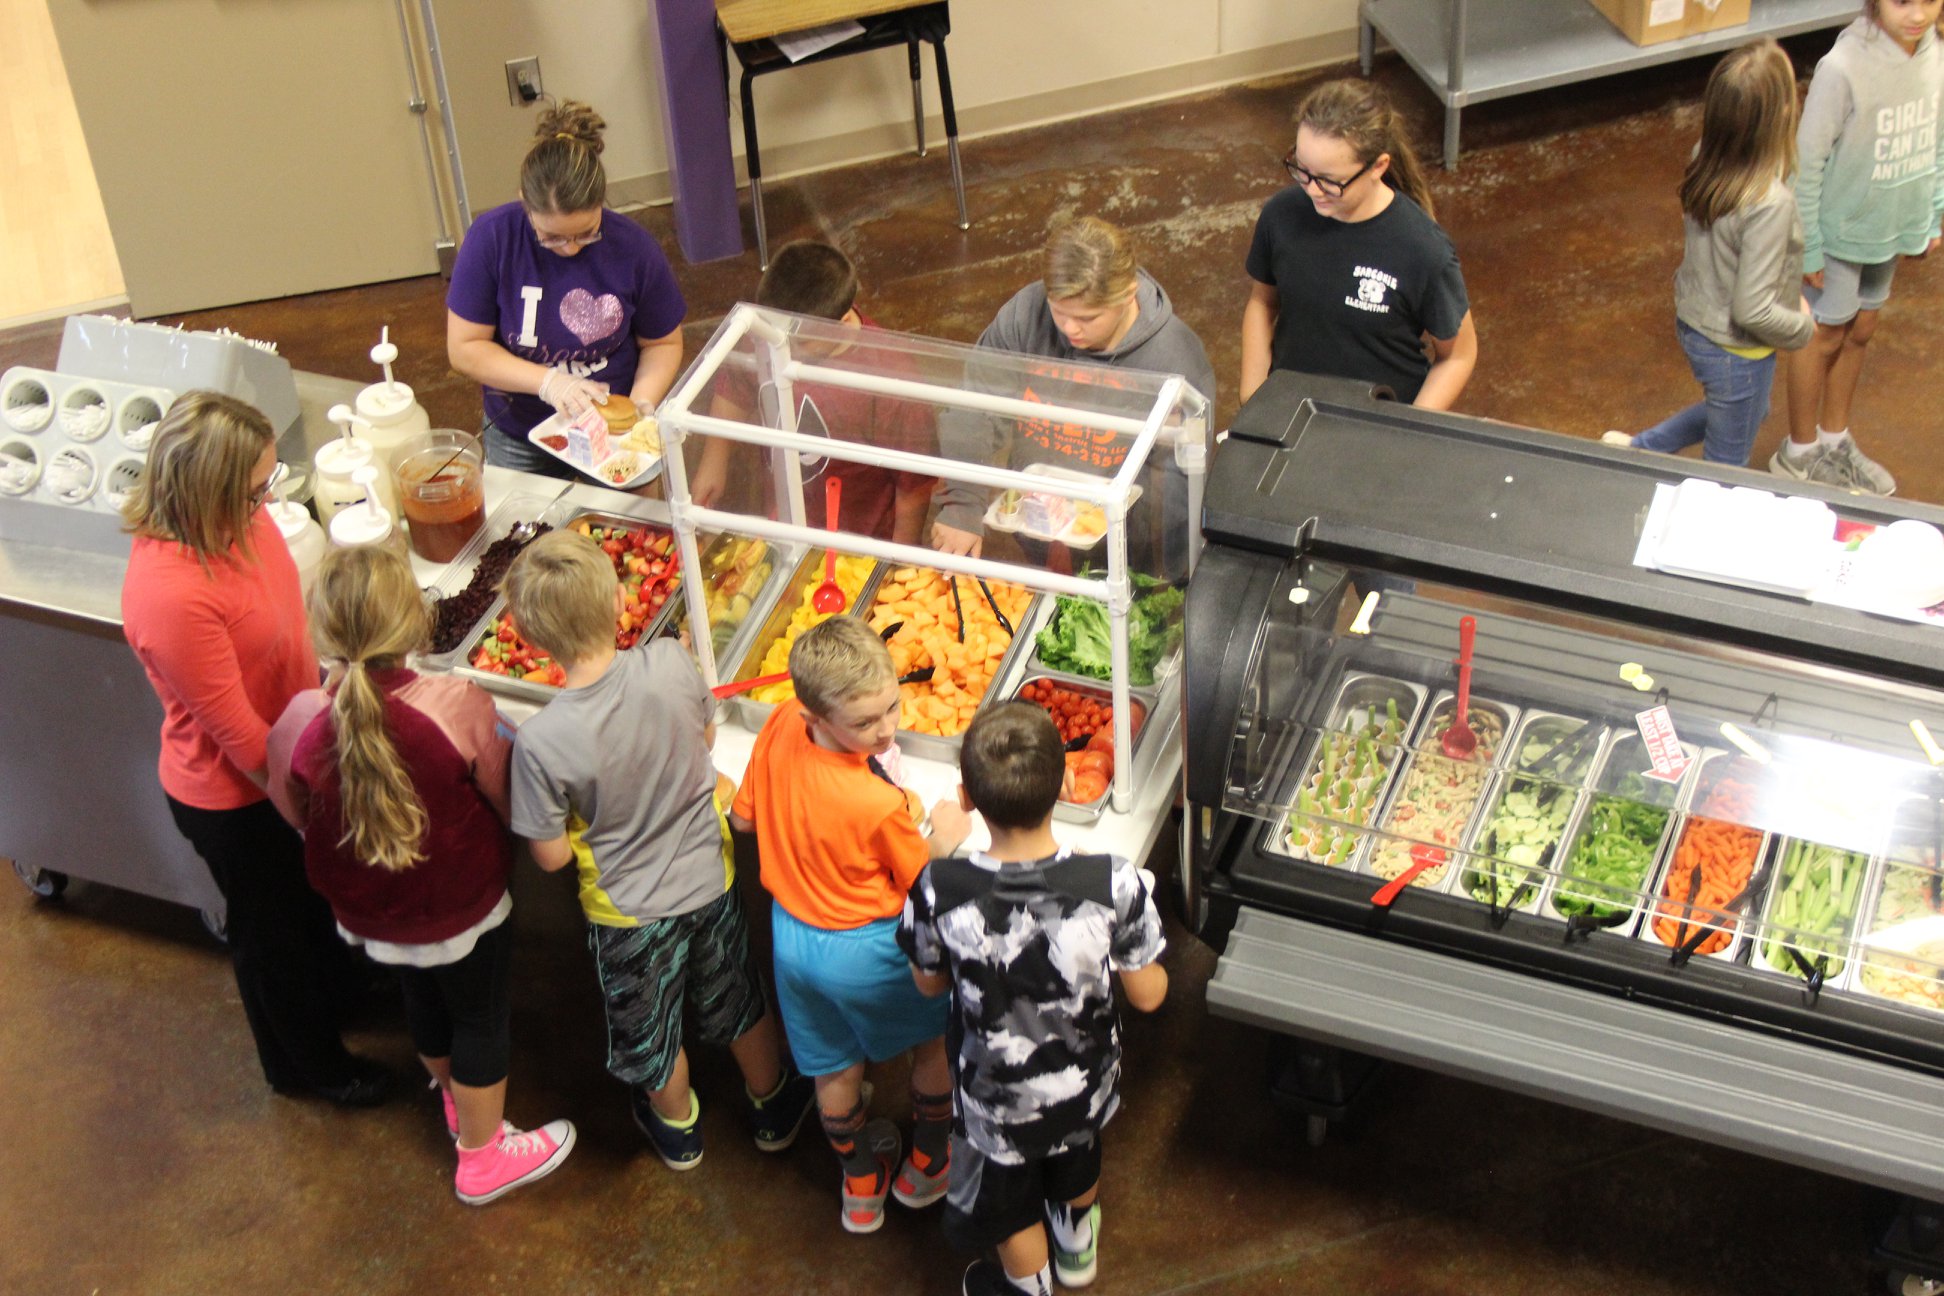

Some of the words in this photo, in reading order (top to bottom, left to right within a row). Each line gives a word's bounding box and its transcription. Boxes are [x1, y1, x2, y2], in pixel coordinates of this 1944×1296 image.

[1877, 91, 1939, 135] GIRLS
[1874, 132, 1912, 161] CAN
[1353, 266, 1397, 290] SARCOXIE
[1345, 296, 1390, 313] ELEMENTARY
[518, 286, 543, 348] I
[1639, 713, 1660, 743] LEAST
[1649, 741, 1665, 758] 1/2
[1661, 734, 1681, 759] TAKE
[1654, 755, 1672, 776] CUP
[1668, 756, 1684, 771] AT
